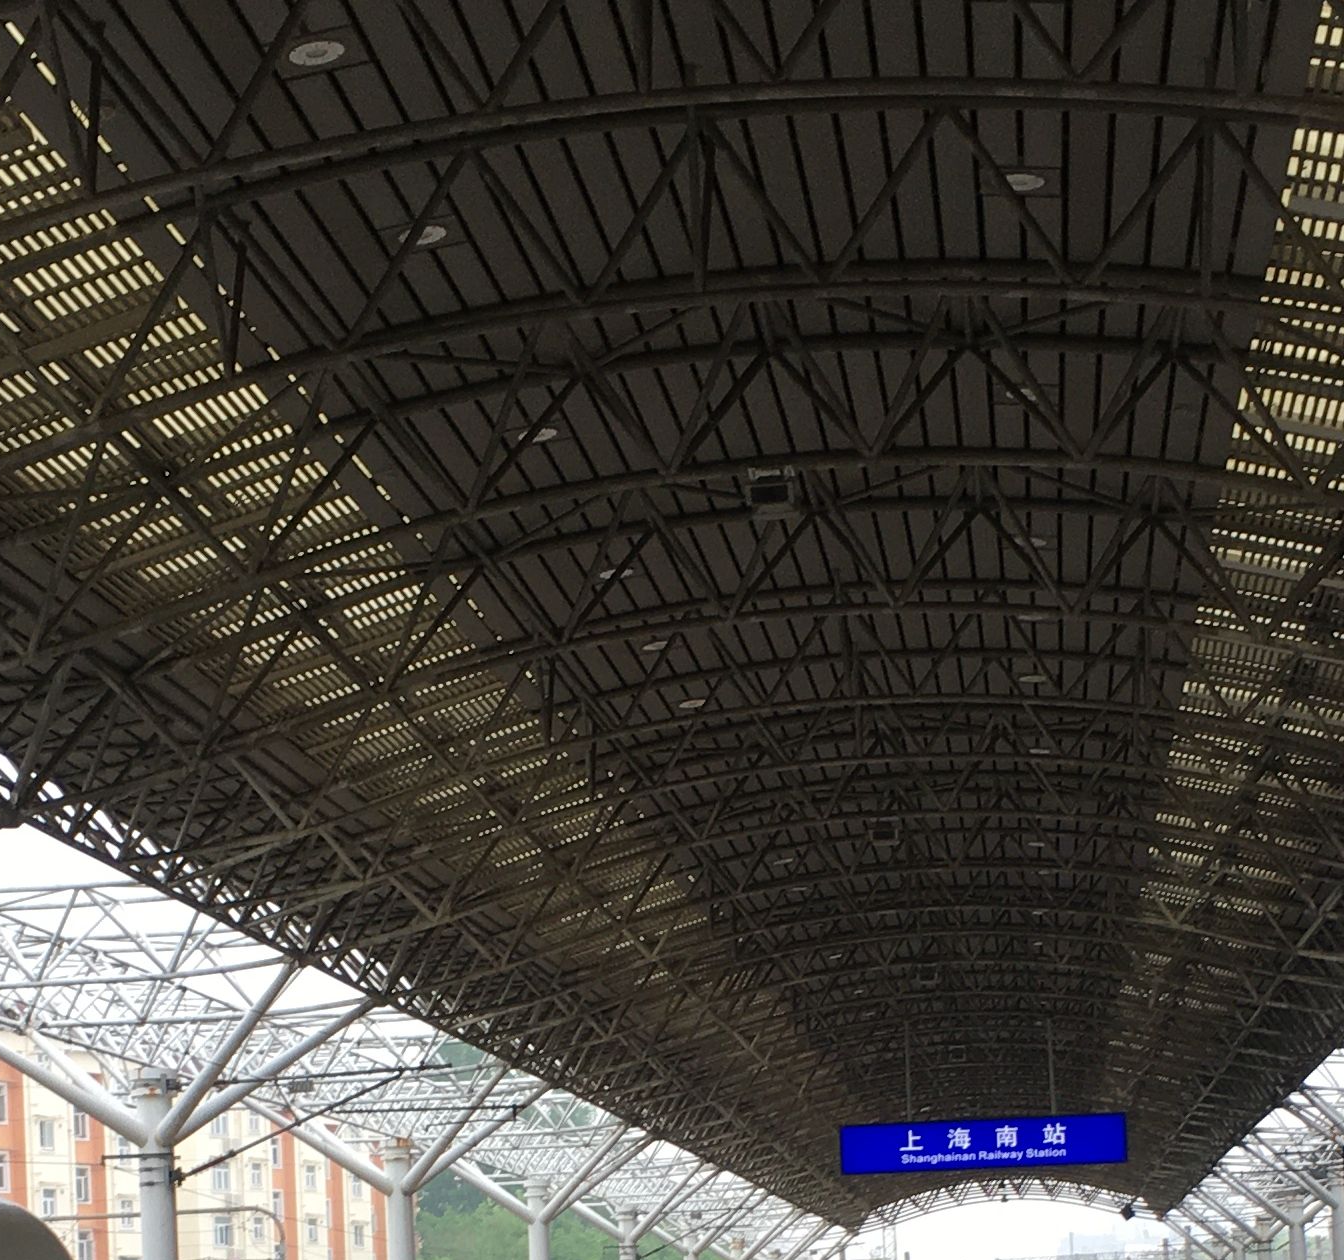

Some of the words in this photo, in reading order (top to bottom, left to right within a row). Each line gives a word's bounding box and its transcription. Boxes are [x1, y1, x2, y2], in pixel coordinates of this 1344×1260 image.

[899, 1122, 1067, 1151] 上海南站
[901, 1151, 977, 1165] Shanghainan
[978, 1149, 1024, 1161] Railway
[1025, 1147, 1067, 1158] Station
